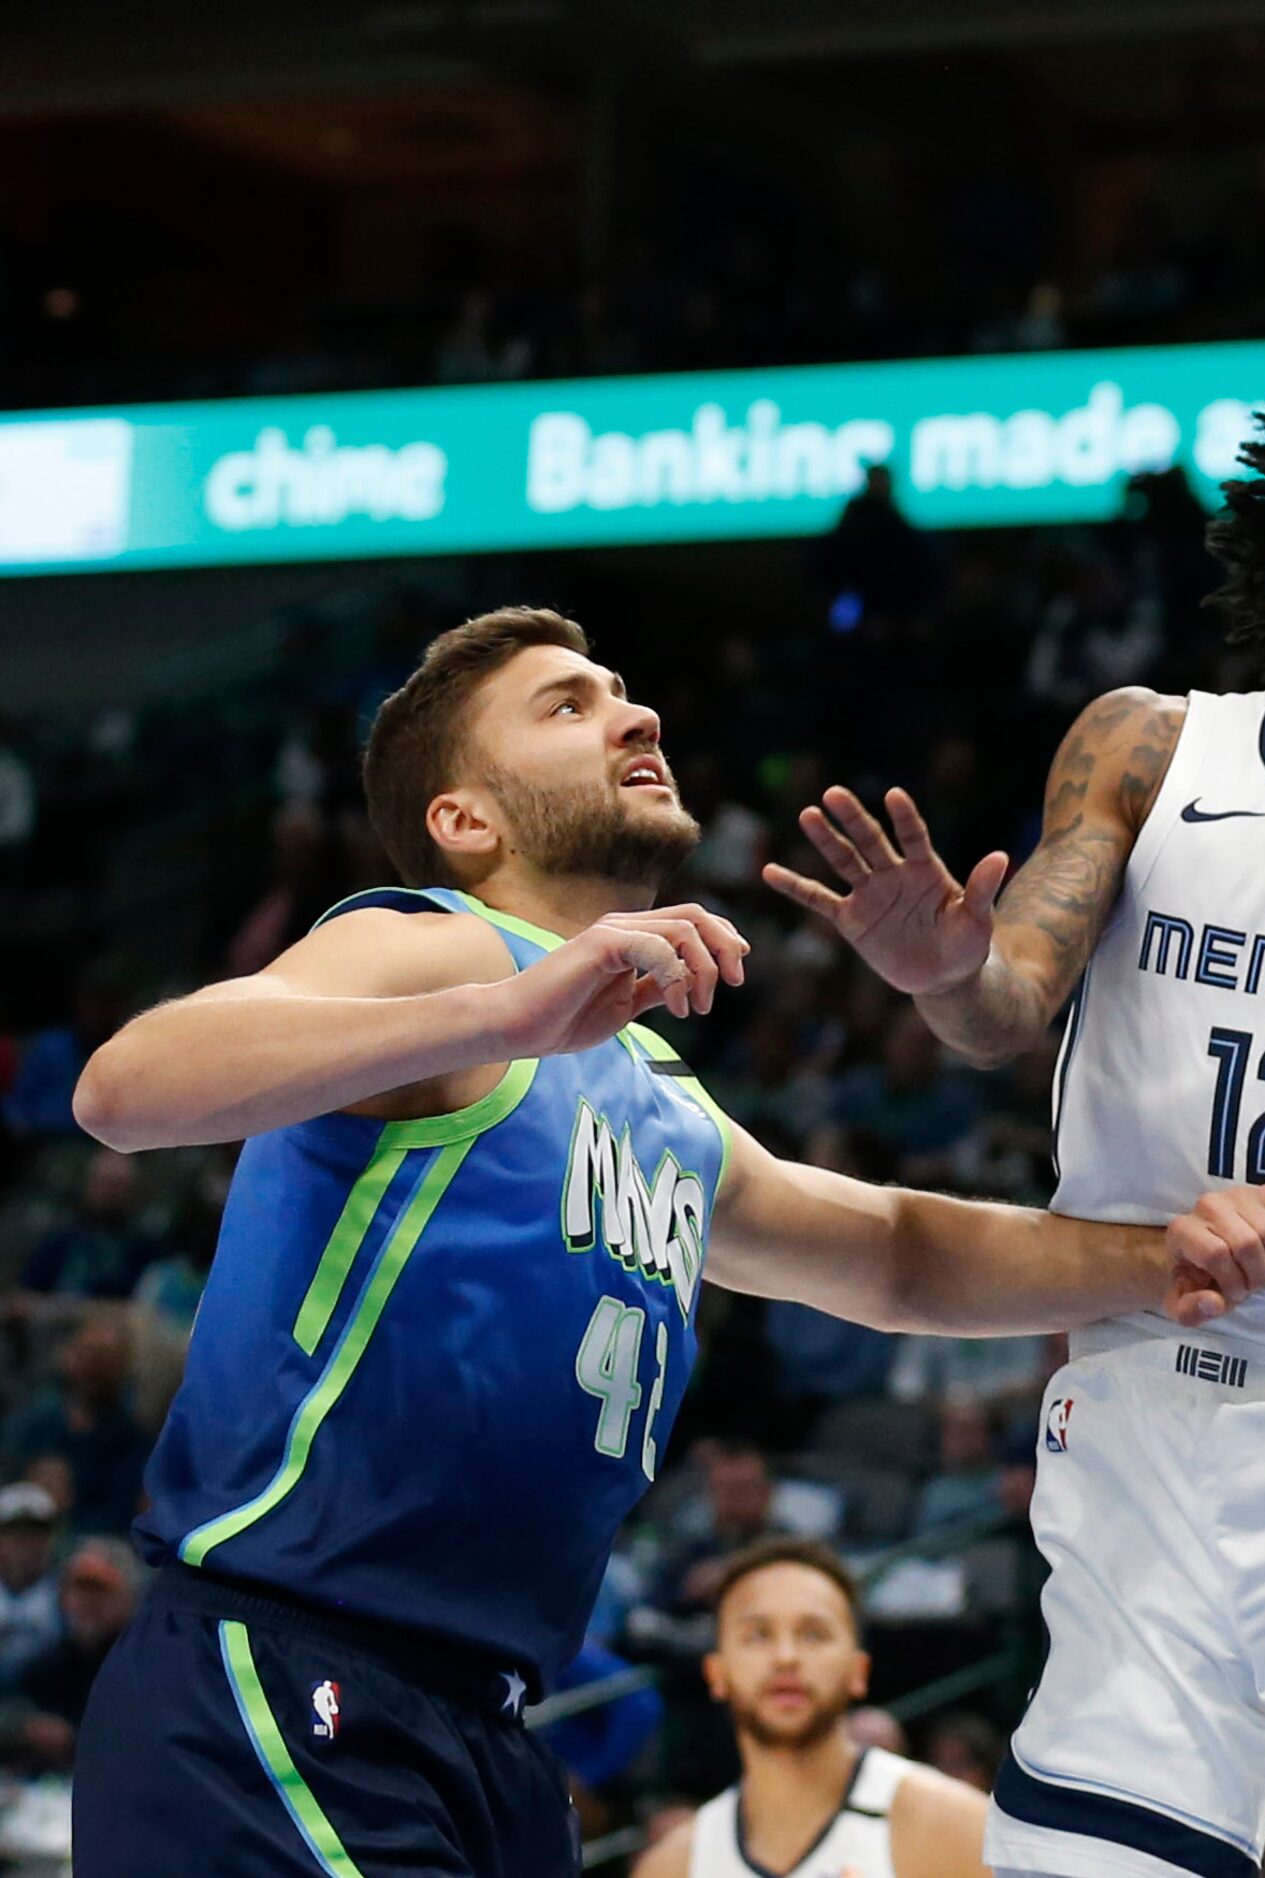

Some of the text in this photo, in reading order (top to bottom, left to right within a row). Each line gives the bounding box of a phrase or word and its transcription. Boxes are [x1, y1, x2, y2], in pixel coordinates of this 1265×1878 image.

[205, 424, 448, 532] chime
[910, 380, 1182, 492] made
[561, 1094, 703, 1328] MAVS
